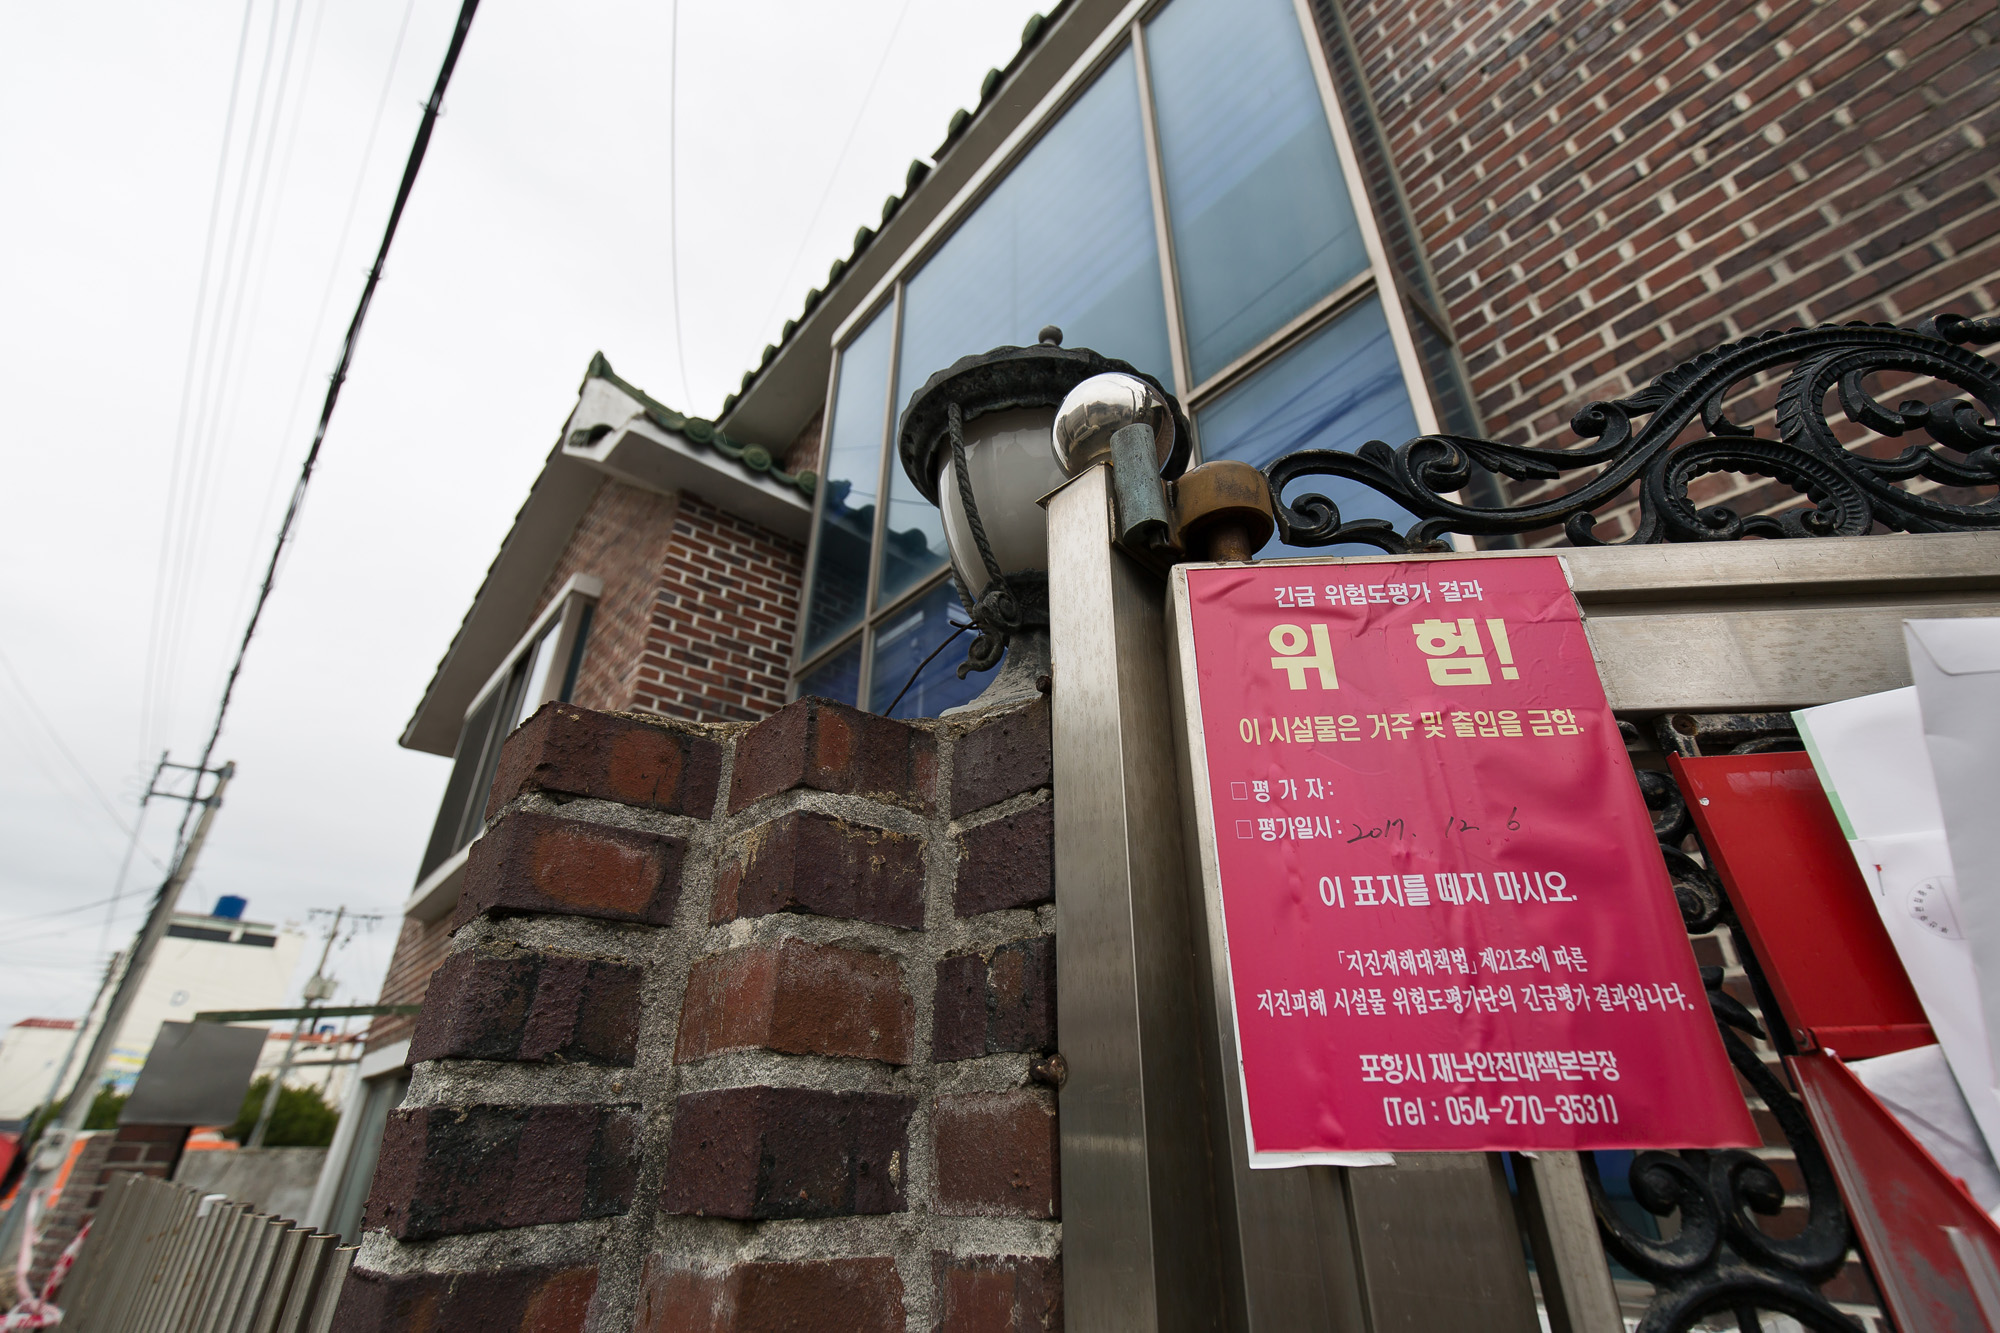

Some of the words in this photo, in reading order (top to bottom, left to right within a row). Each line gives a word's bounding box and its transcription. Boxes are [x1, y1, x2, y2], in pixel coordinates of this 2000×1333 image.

[1273, 585, 1316, 608] 긴급
[1324, 583, 1431, 607] 위험도평가
[1437, 580, 1483, 603] 결과
[1267, 623, 1340, 690] 위
[1411, 618, 1520, 687] 험!
[1238, 717, 1262, 746] 이
[1268, 714, 1361, 744] 시설물은
[1369, 713, 1414, 741] 거주
[1420, 711, 1447, 739] 및
[1451, 710, 1523, 737] 출입을
[1529, 708, 1585, 737] 금함.
[1252, 779, 1271, 802] 평
[1279, 778, 1297, 801] 가
[1444, 816, 1479, 838] 12
[1507, 806, 1521, 831] 6
[1318, 875, 1345, 908] 이
[1350, 874, 1431, 907] 표지를
[1495, 871, 1578, 904] 마시오.
[1479, 945, 1551, 974] 제21조에
[1552, 944, 1588, 973] 따른
[1257, 988, 1328, 1018] 지진피해
[1333, 987, 1387, 1017] 시설물
[1391, 985, 1517, 1016] 위험도평가단의
[1522, 984, 1591, 1013] 긴급평가
[1595, 983, 1695, 1013] 결과입니다.
[1359, 1053, 1427, 1084] 포항시
[1428, 1051, 1620, 1082] 재난안전대책본부장
